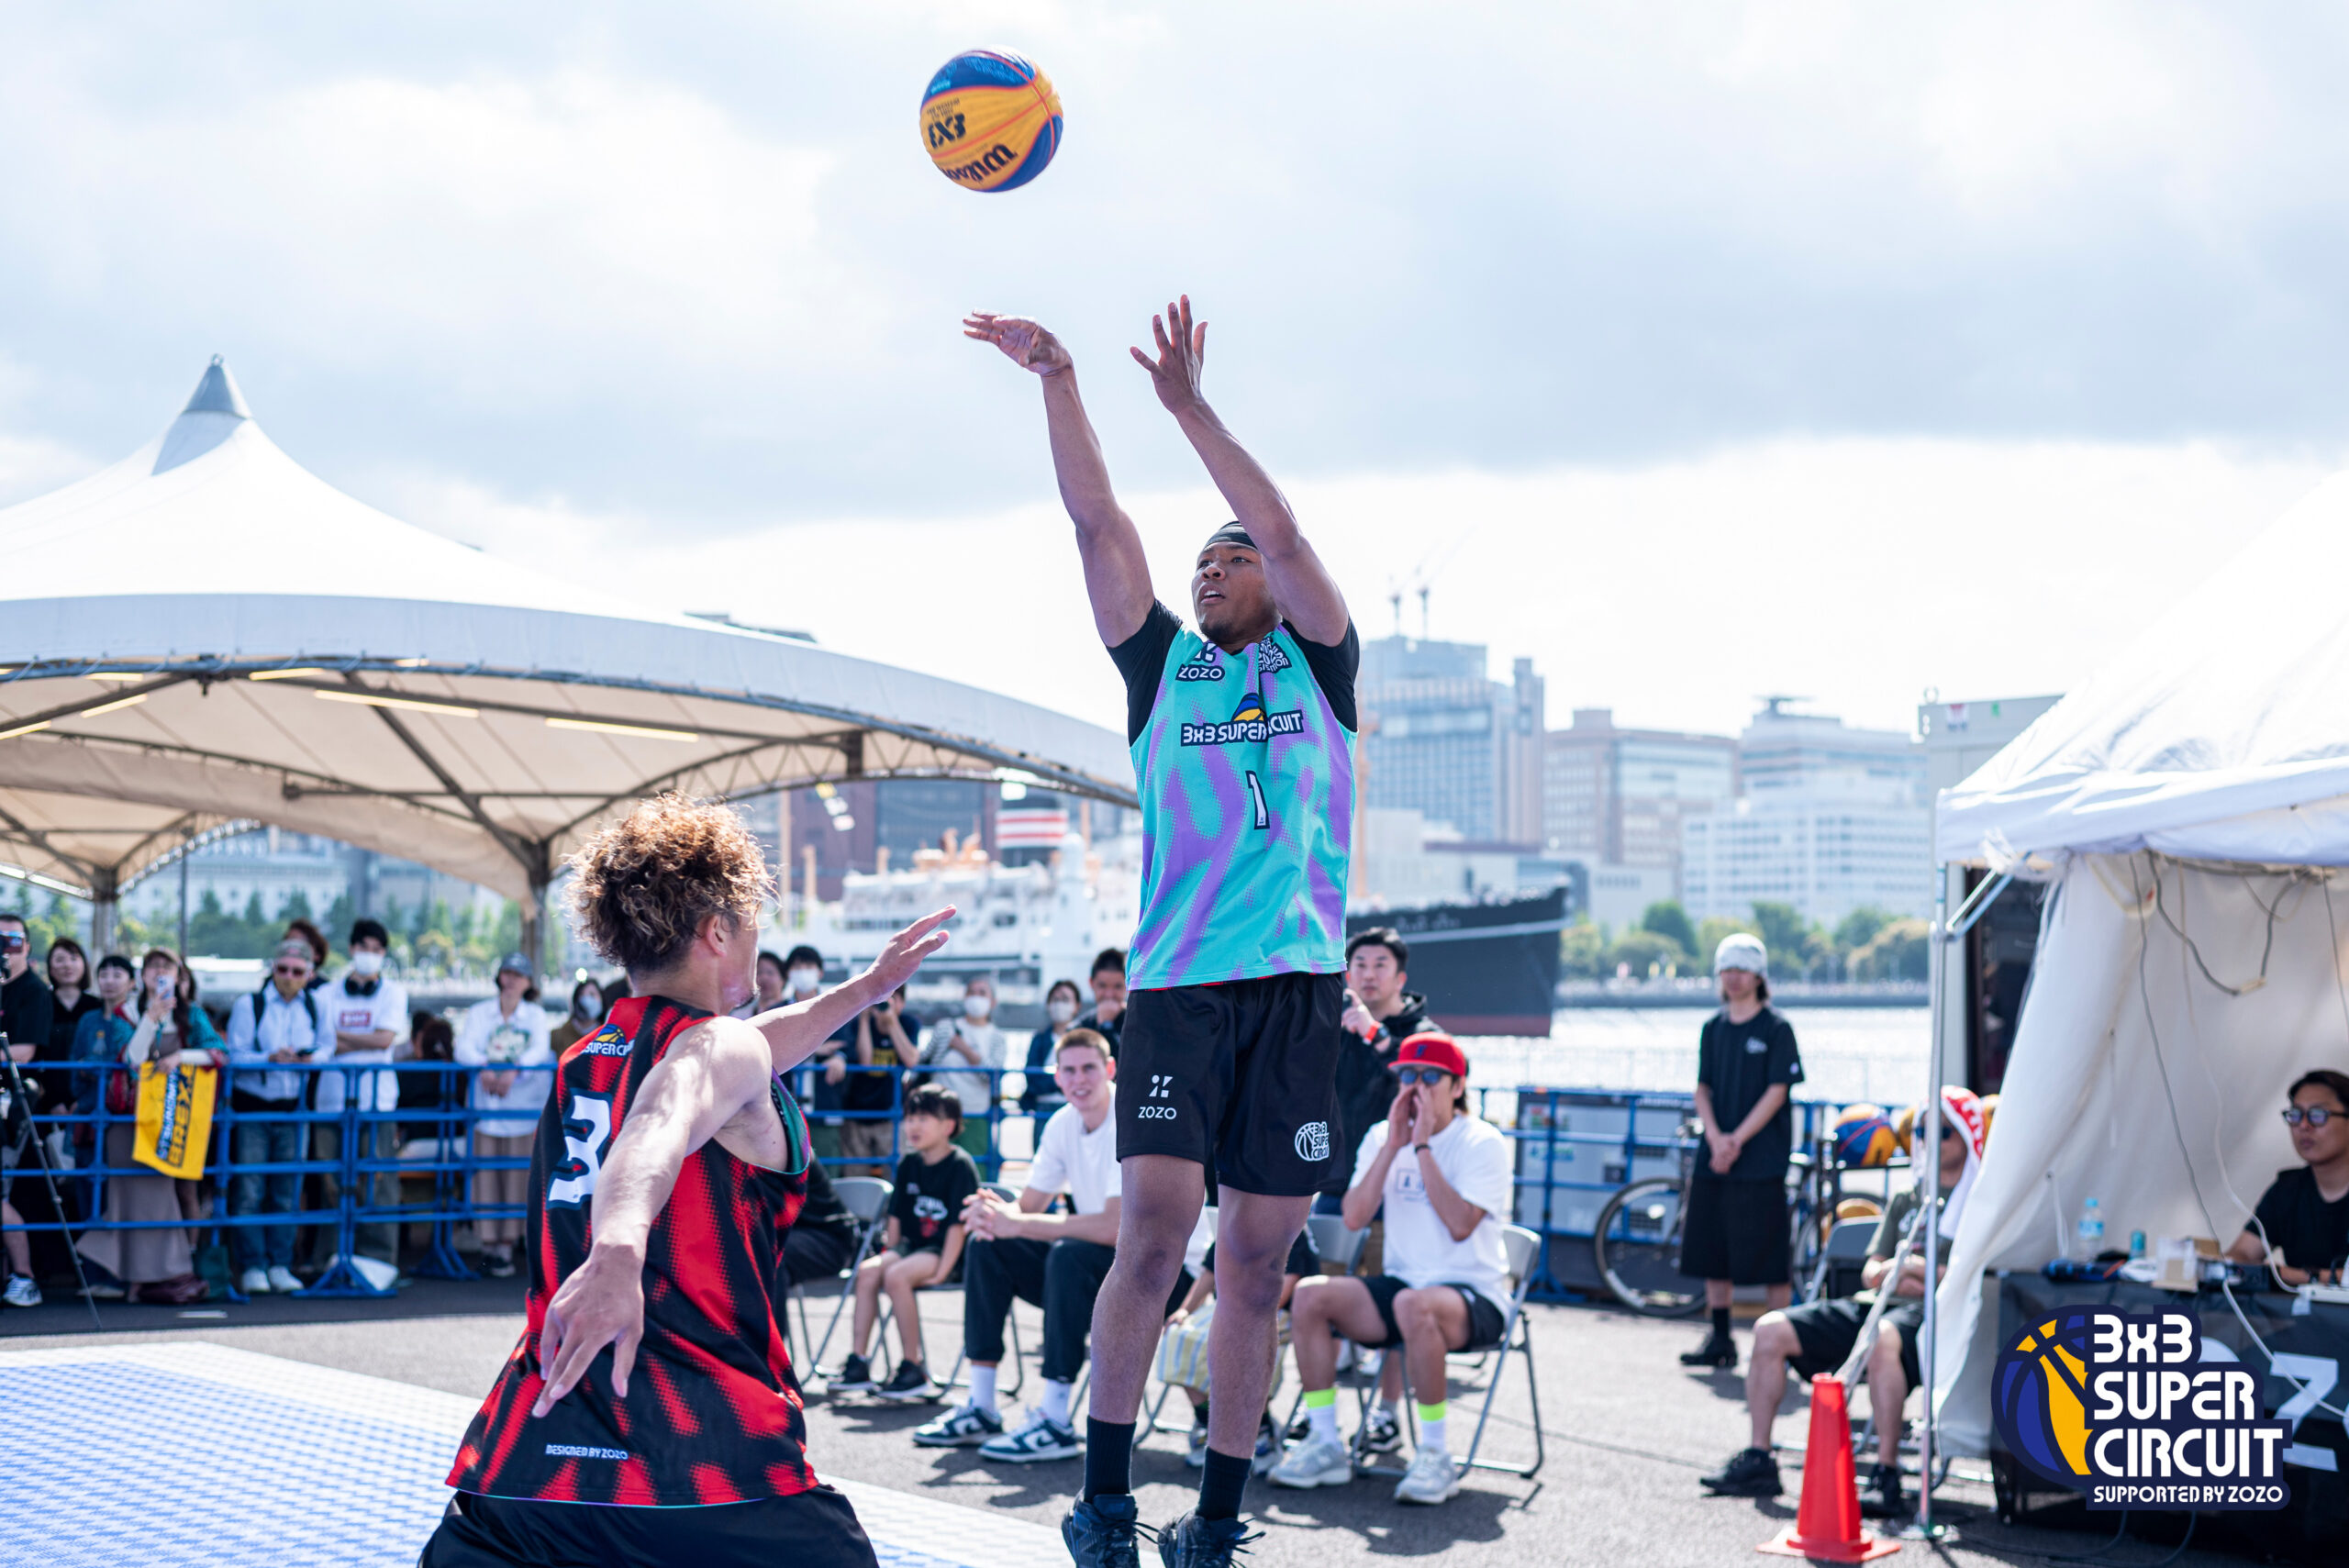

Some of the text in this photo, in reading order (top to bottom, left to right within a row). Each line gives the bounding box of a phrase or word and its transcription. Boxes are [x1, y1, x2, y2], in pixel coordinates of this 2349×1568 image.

[1178, 666, 1222, 680] ZOZO
[1217, 721, 1267, 742] SUPER
[1248, 773, 1266, 826] 1
[1138, 1106, 1177, 1120] ZOZO
[588, 1447, 601, 1458] BY
[601, 1448, 629, 1460] ZOZO
